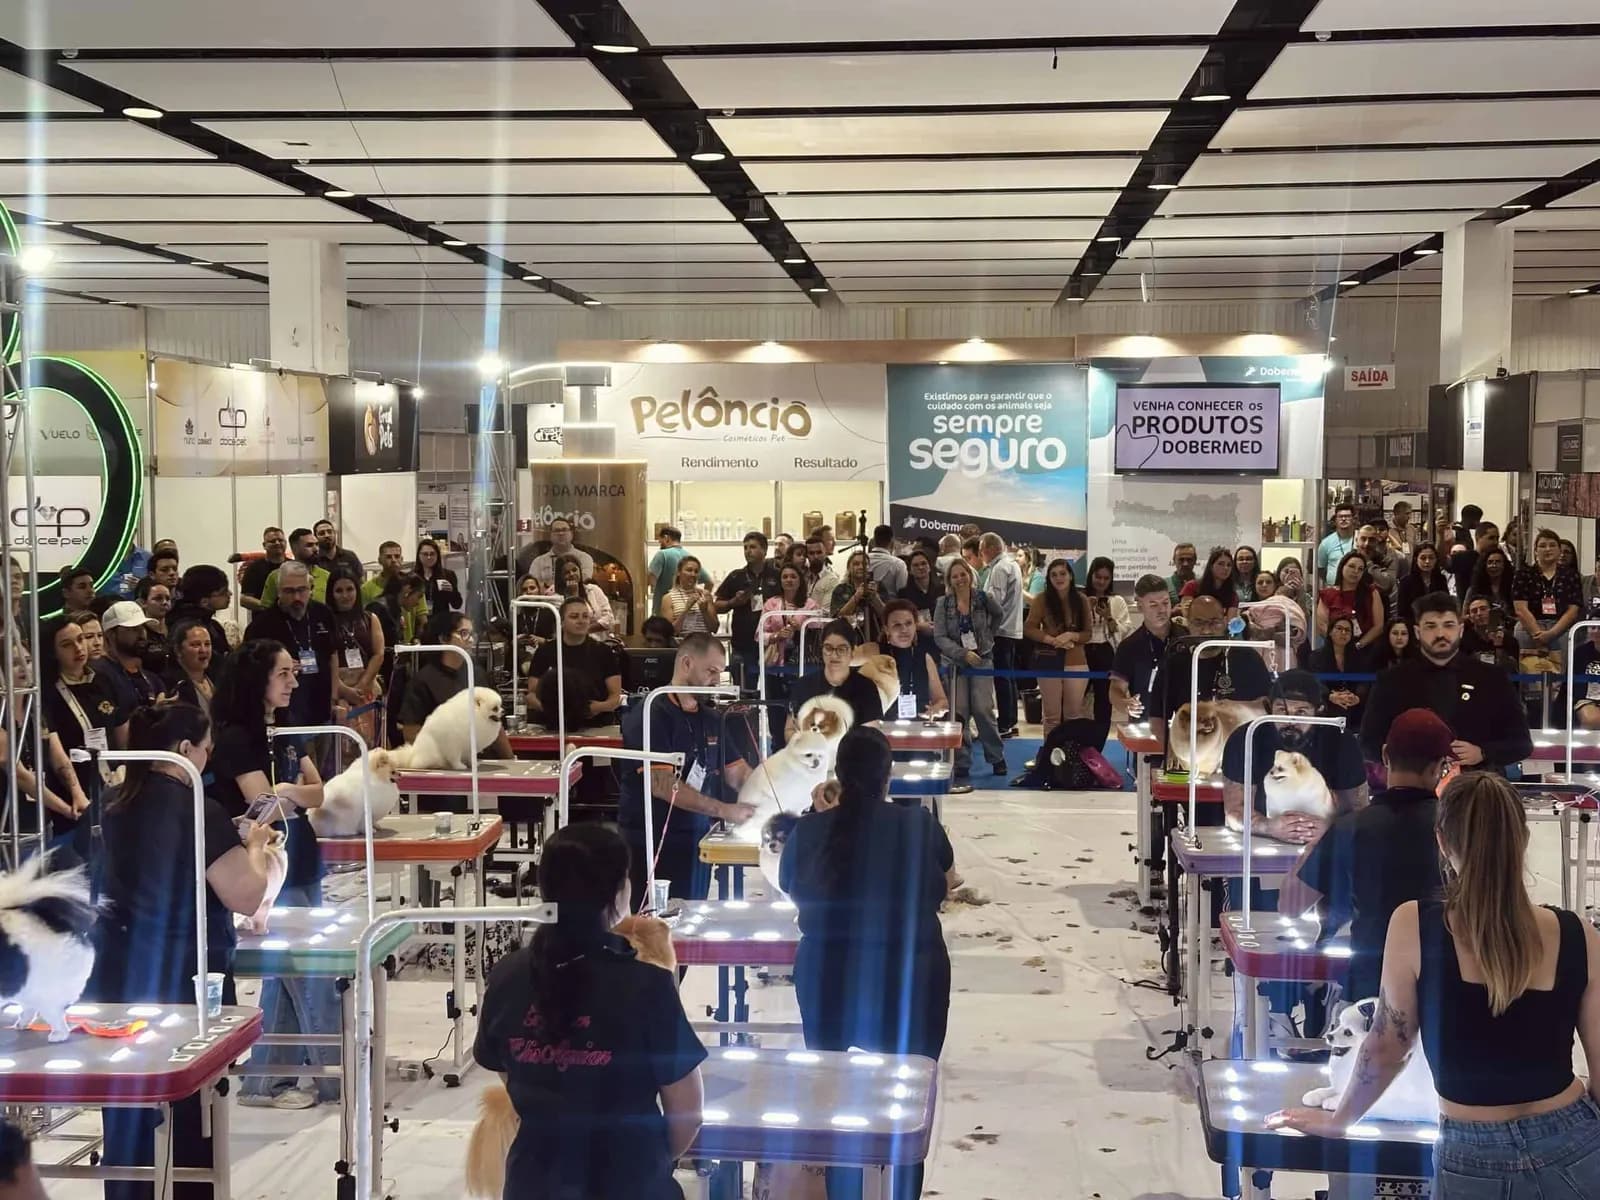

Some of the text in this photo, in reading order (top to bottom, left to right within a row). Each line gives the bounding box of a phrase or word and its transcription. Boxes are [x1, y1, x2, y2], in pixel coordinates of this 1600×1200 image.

[1351, 368, 1389, 382] SAÍDA
[924, 392, 968, 401] Existimos
[969, 393, 989, 402] para
[990, 391, 1026, 402] garantir
[1027, 392, 1045, 401] que
[630, 386, 812, 437] Pelôncio
[927, 401, 1052, 411] cuidado com os animais seja
[1133, 400, 1174, 411] VENHA
[1177, 400, 1244, 411] CONHECER
[933, 414, 1043, 437] sempre
[1132, 415, 1264, 434] PRODUTOS
[771, 433, 785, 442] Pet
[1162, 440, 1263, 454] DOBERMED
[681, 456, 759, 468] Rendimento
[794, 456, 858, 468] Resultado
[909, 437, 1067, 479] seguro
[552, 484, 570, 496] DA
[574, 484, 626, 497] MARCA
[920, 518, 963, 532] Doberm
